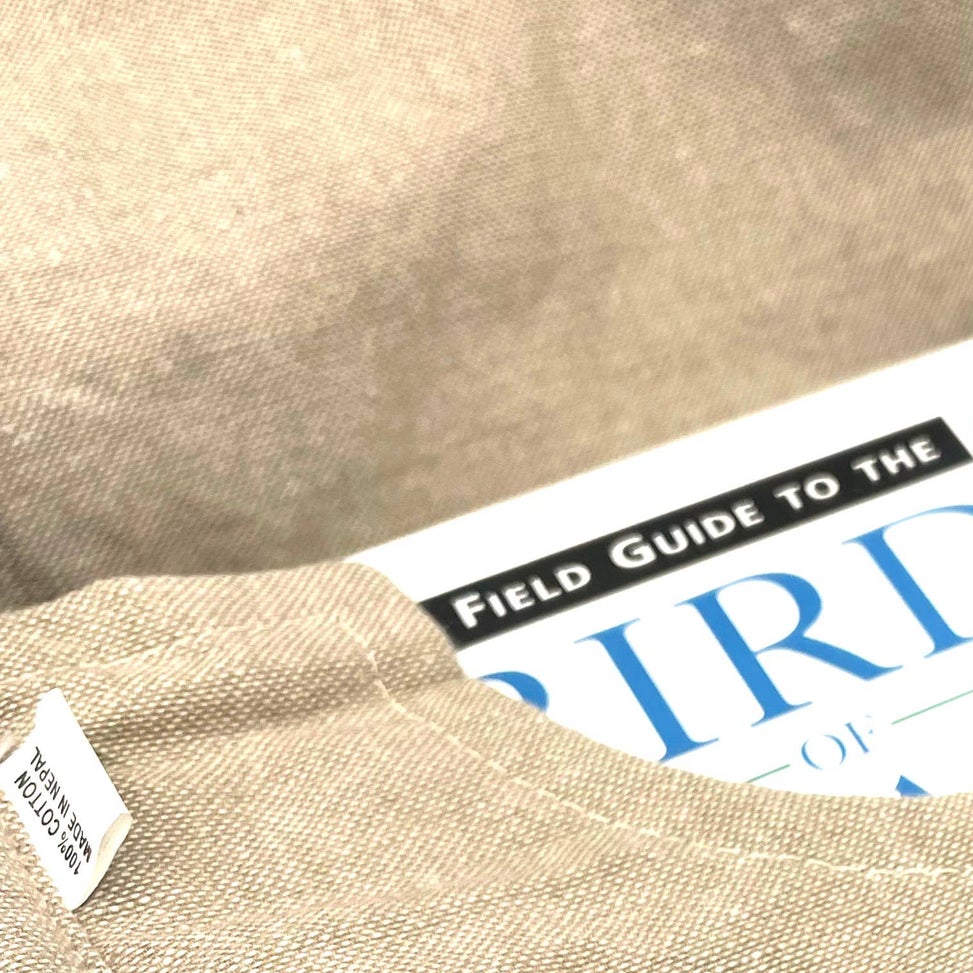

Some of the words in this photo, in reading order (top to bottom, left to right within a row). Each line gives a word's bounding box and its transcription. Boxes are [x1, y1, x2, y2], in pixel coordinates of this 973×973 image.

[452, 563, 592, 629] FIELD
[609, 501, 765, 569] GUIDE
[774, 473, 840, 511] TO
[851, 435, 941, 482] THE
[801, 714, 873, 771] OF
[30, 746, 61, 801] NEPAL
[14, 770, 60, 836] COTTON
[57, 794, 70, 818] IN
[57, 831, 82, 875] 100%
[67, 811, 93, 863] MADE
